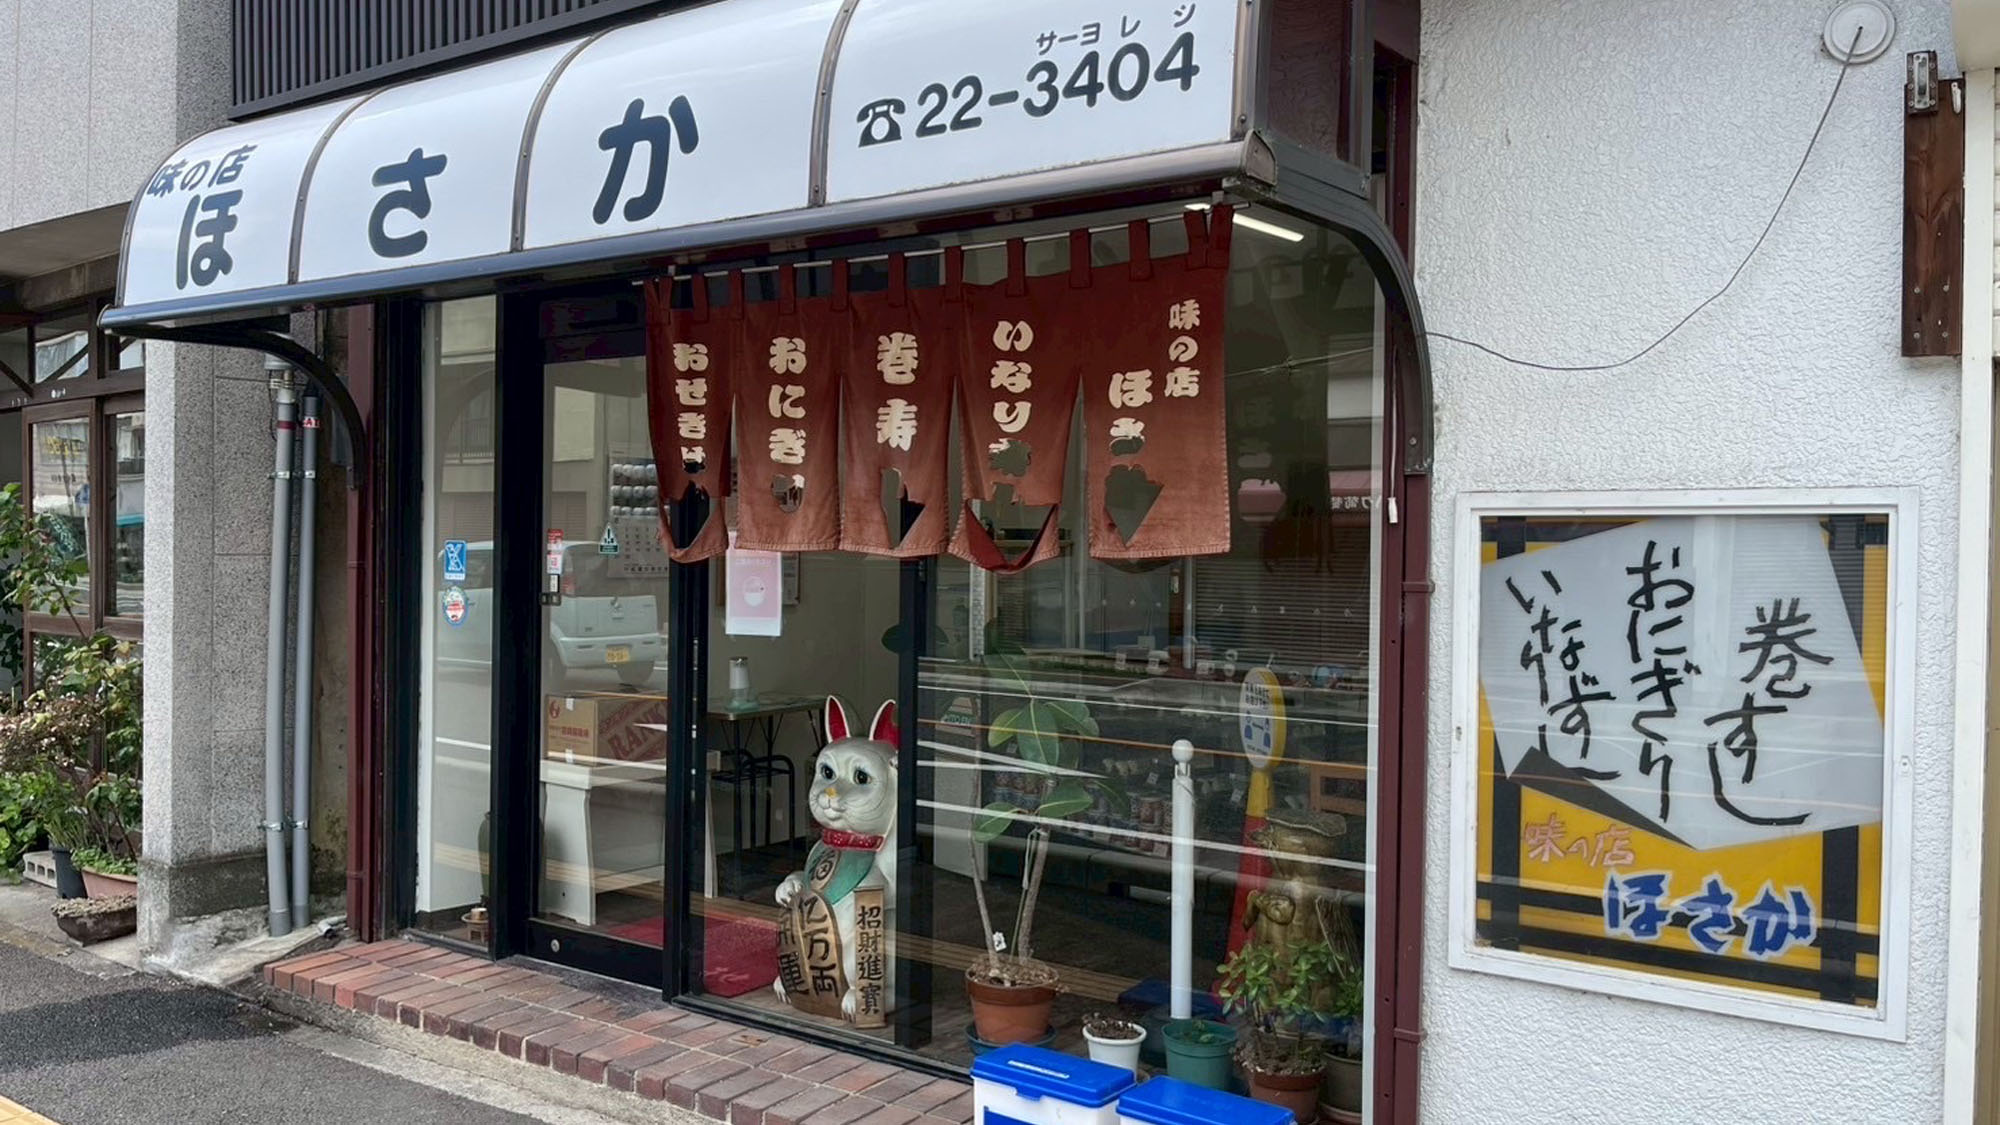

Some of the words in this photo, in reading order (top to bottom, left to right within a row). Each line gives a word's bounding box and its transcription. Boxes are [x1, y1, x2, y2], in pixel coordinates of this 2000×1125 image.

[916, 32, 1200, 138] 22-3404
[147, 144, 258, 198] 味の店
[176, 95, 699, 290] ほさか
[768, 337, 807, 492] おにぎ
[876, 332, 918, 475] 巻寿
[1164, 299, 1200, 397] 味の店
[1506, 569, 1622, 781] いなりずし
[1625, 540, 1701, 823] おにぎり
[1704, 597, 1834, 826] 巻すし
[1524, 813, 1635, 867] 味の店
[1604, 870, 1814, 957] ほさか
